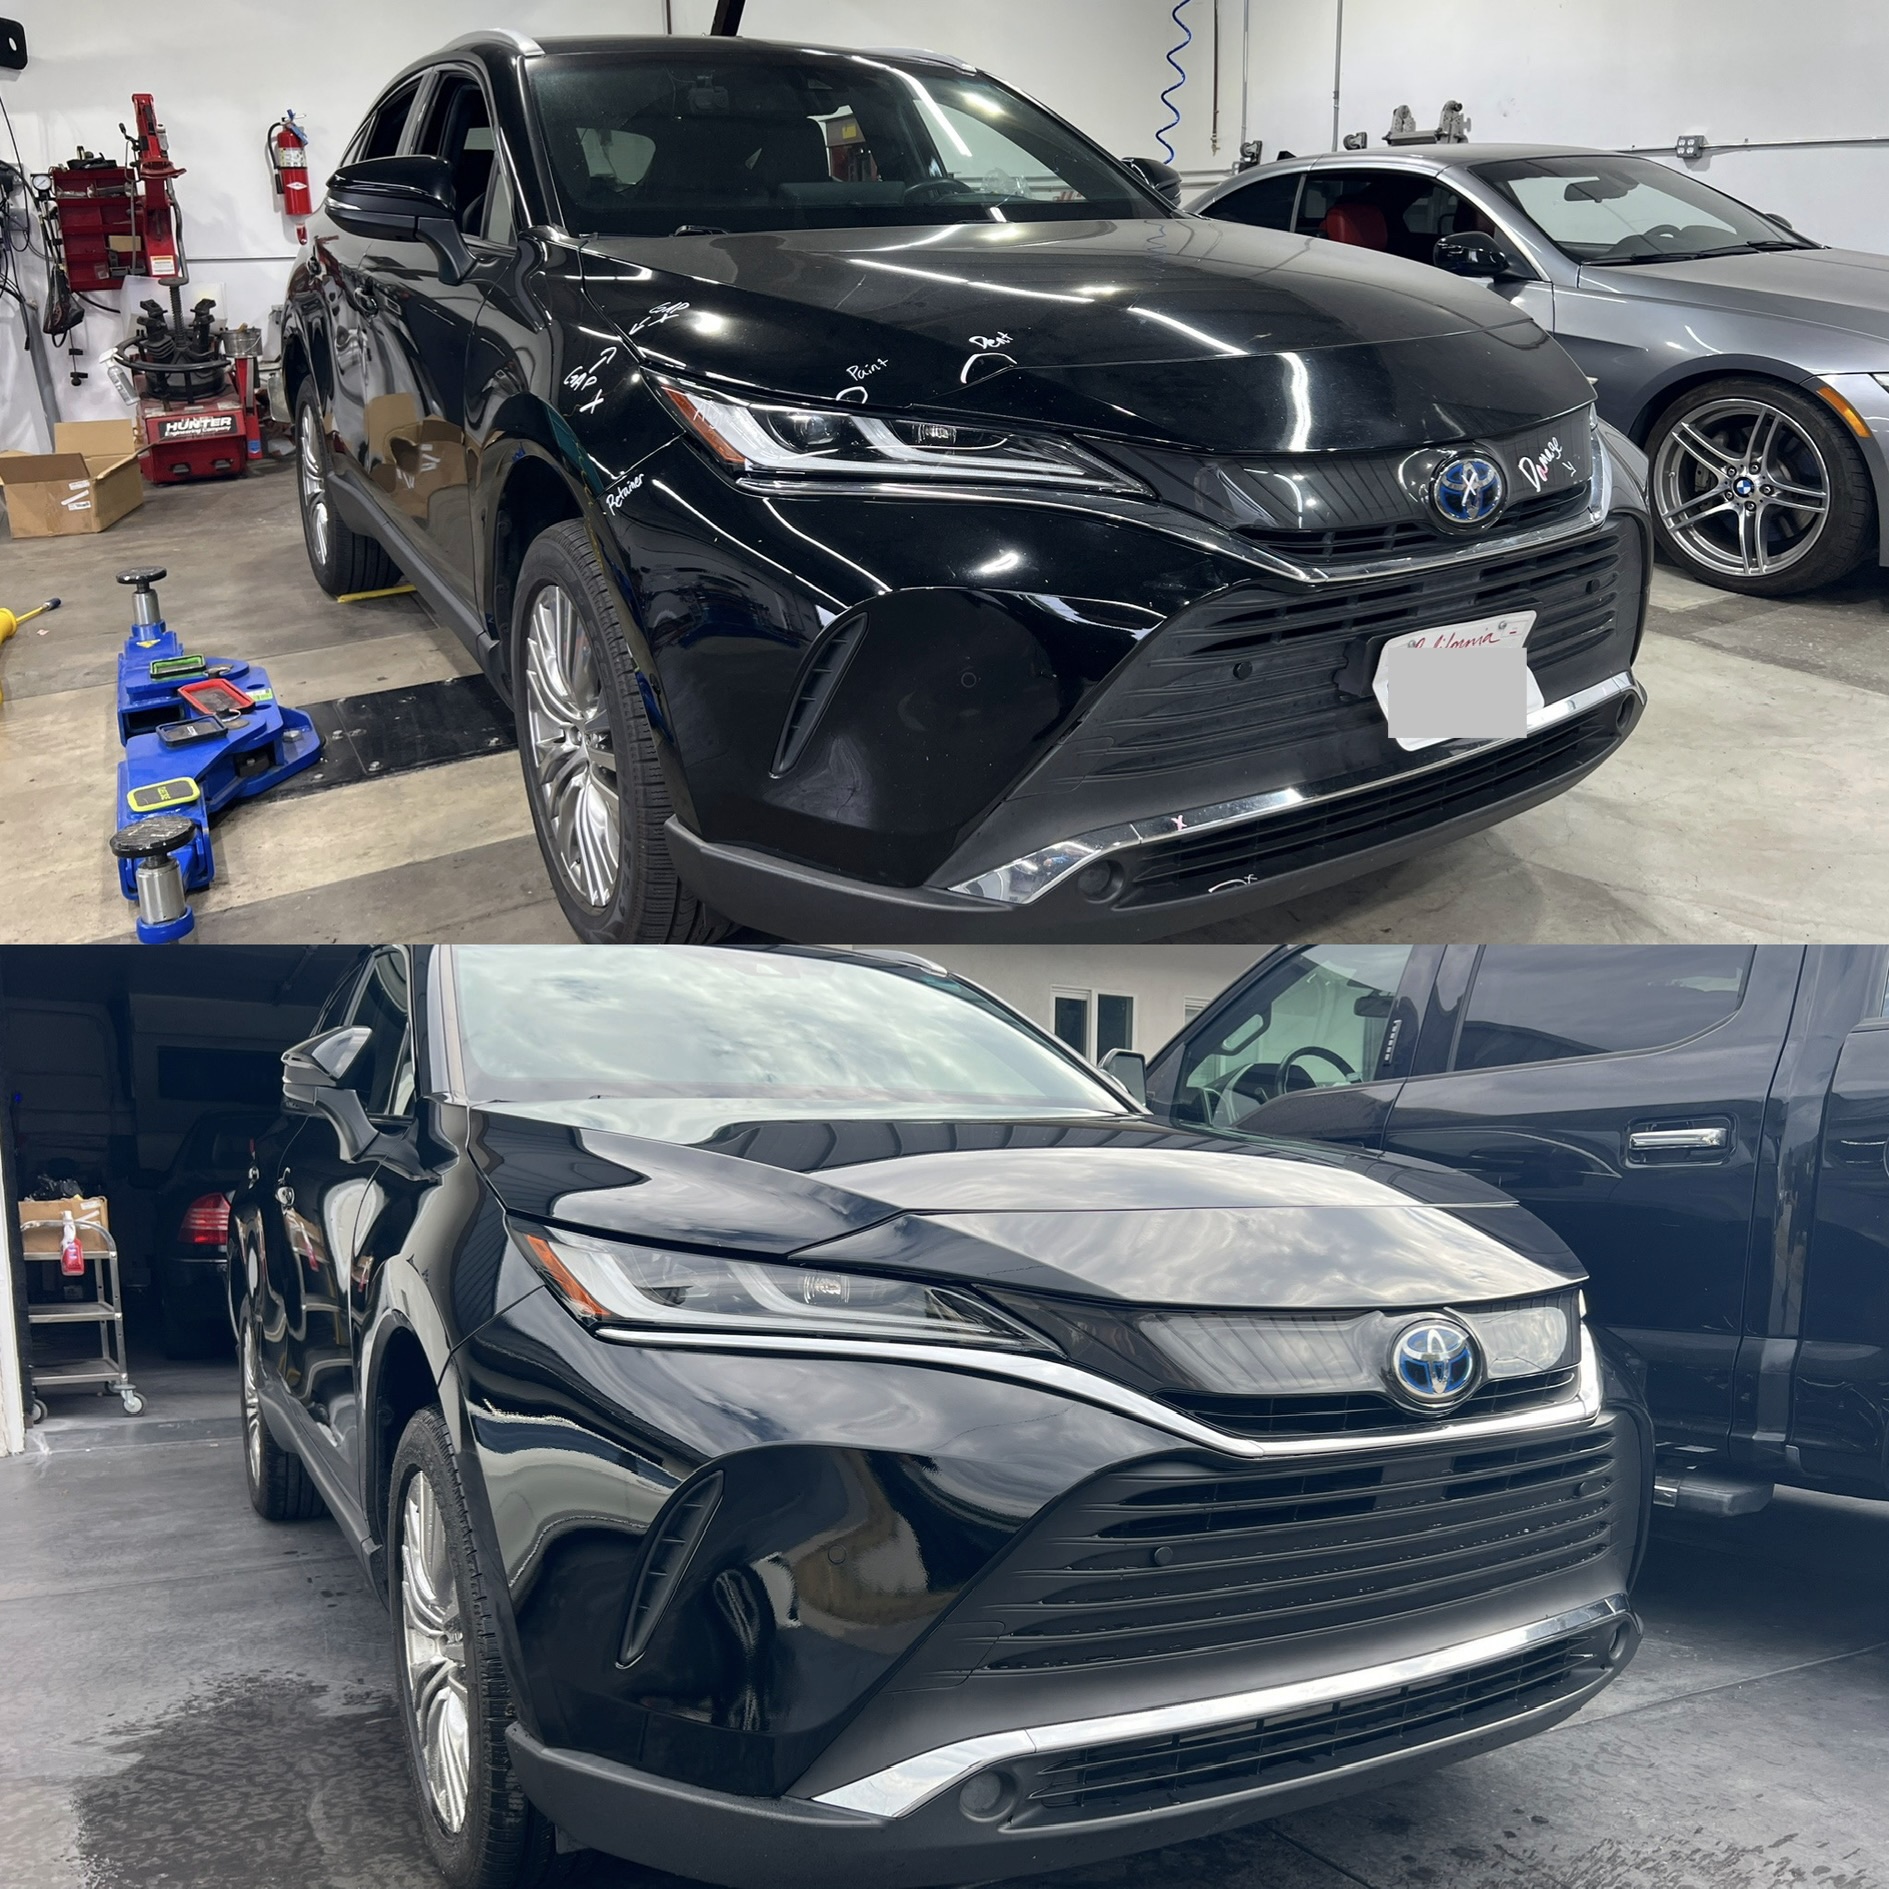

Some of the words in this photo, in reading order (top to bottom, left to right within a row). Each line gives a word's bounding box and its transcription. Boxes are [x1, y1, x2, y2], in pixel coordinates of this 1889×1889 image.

[649, 301, 690, 314] GAP
[969, 331, 1013, 349] Dent
[563, 365, 598, 391] GAP
[846, 358, 889, 381] Paint
[166, 416, 232, 432] HUNTER
[1518, 436, 1563, 493] Damage
[605, 473, 645, 516] Retainer
